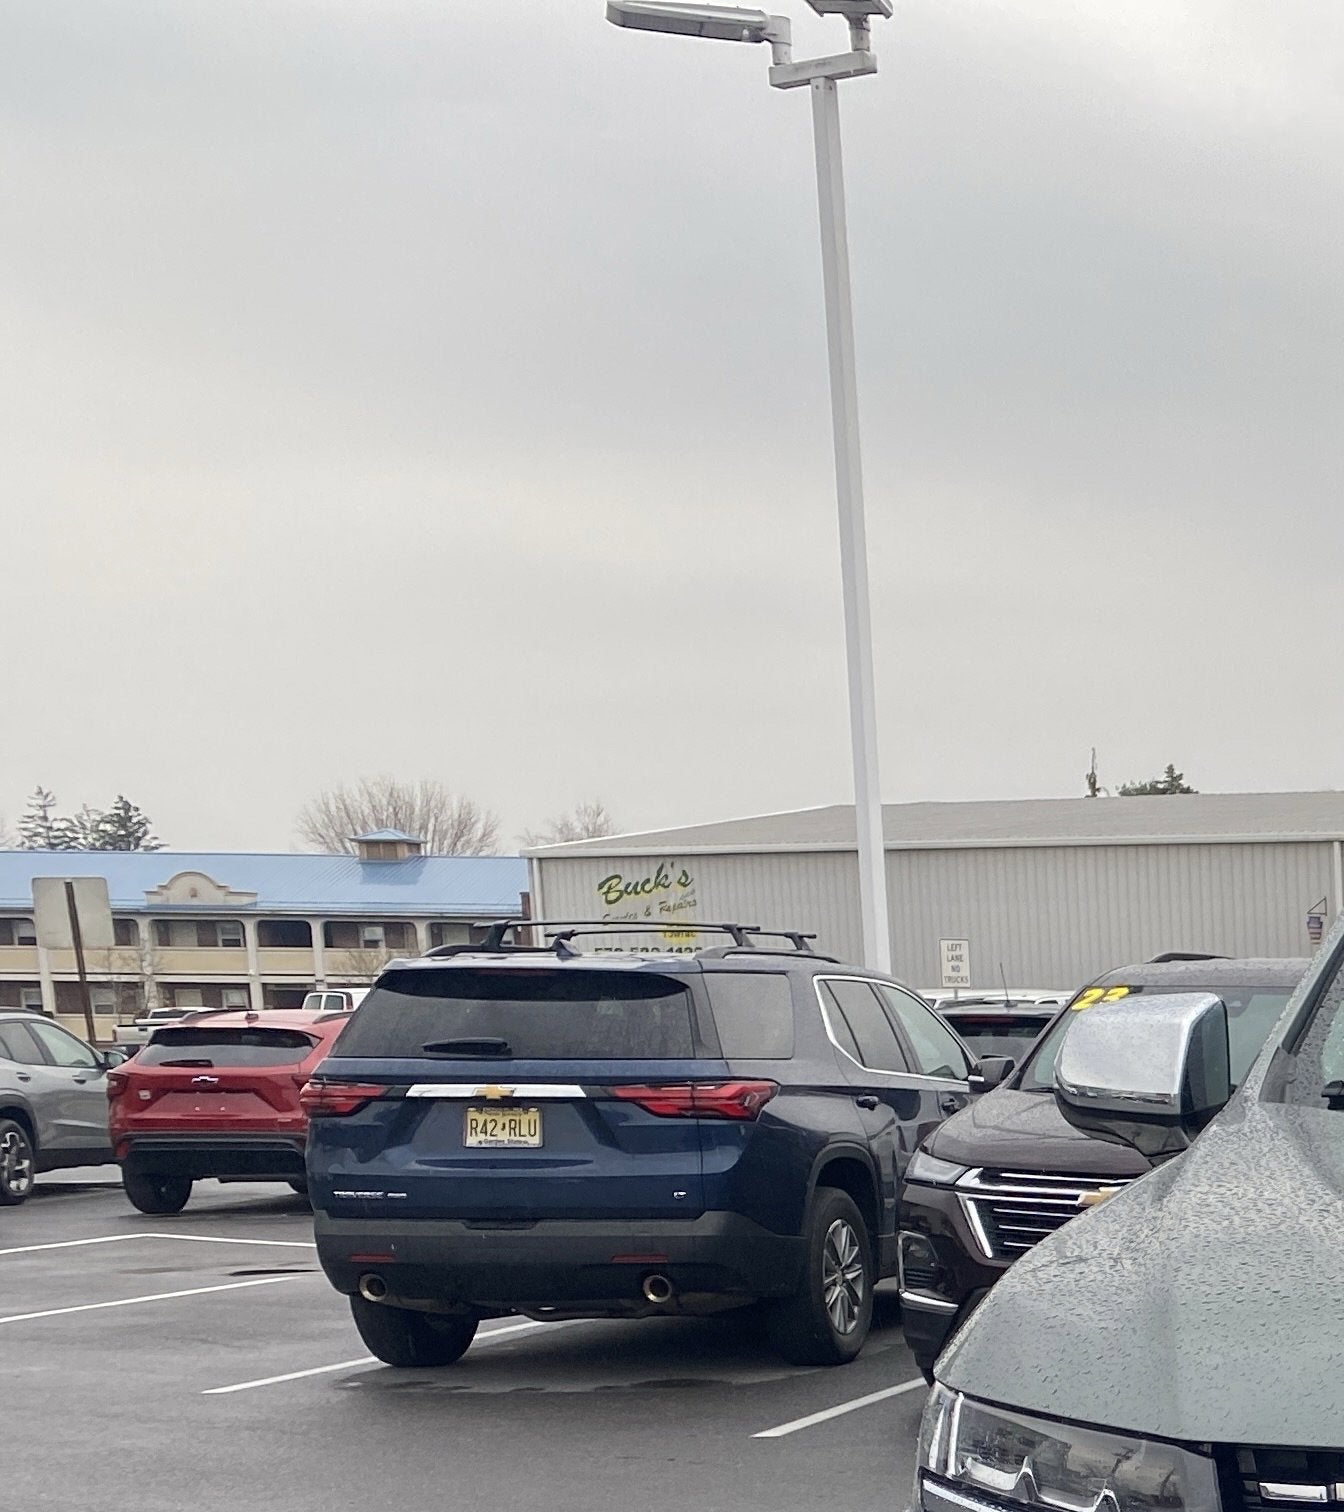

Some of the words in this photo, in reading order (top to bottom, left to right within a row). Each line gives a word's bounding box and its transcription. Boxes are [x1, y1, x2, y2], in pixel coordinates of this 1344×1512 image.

[597, 861, 695, 905] Buck's
[946, 943, 963, 952] LEFT
[946, 954, 964, 963] LANE
[943, 975, 969, 984] TRUCKS
